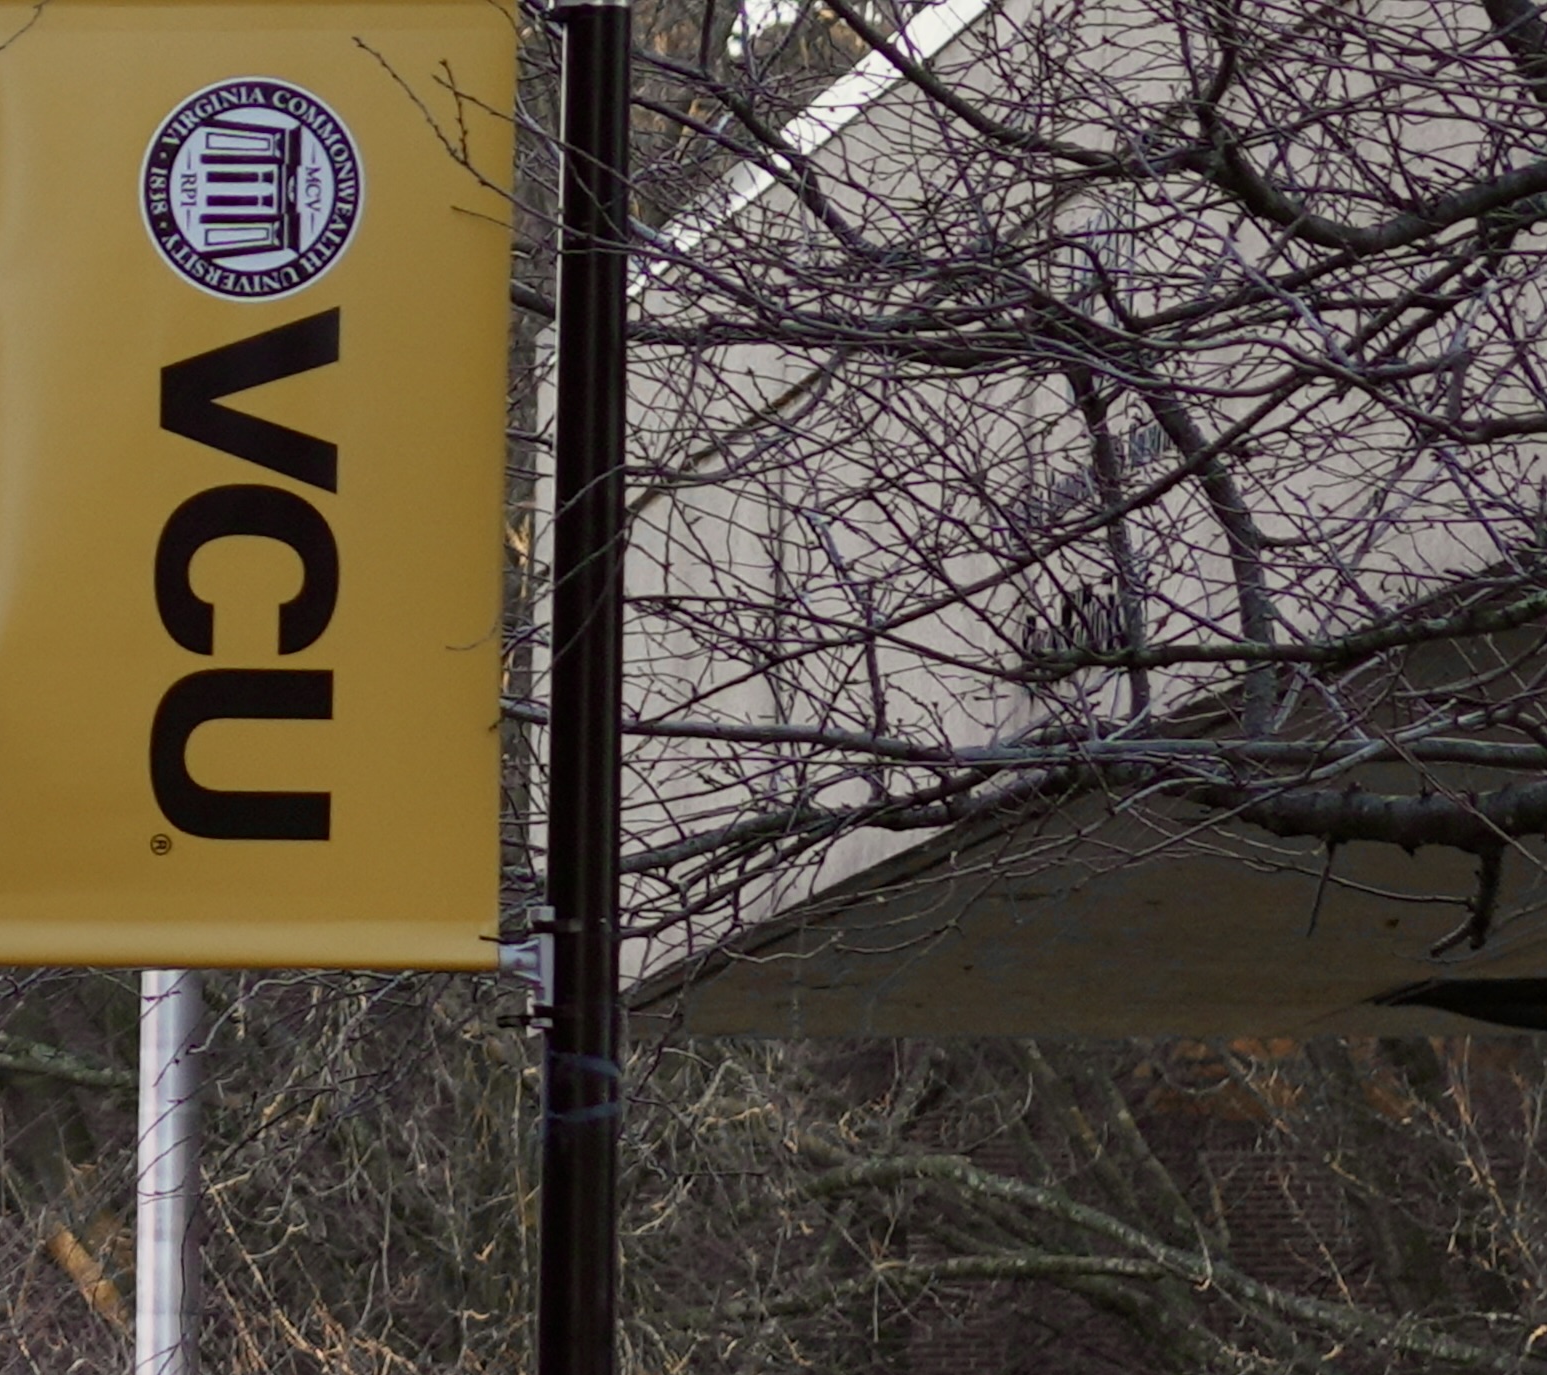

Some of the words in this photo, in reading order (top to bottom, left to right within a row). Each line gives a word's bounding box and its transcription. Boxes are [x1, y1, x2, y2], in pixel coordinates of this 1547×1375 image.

[162, 86, 266, 147] VIRGINIA
[149, 166, 169, 215] 1838
[179, 172, 198, 208] RPI
[271, 89, 357, 274] COMMONWEALTH
[304, 166, 323, 212] MCV
[161, 233, 301, 293] UNIVERSITY
[149, 305, 341, 842] VCU
